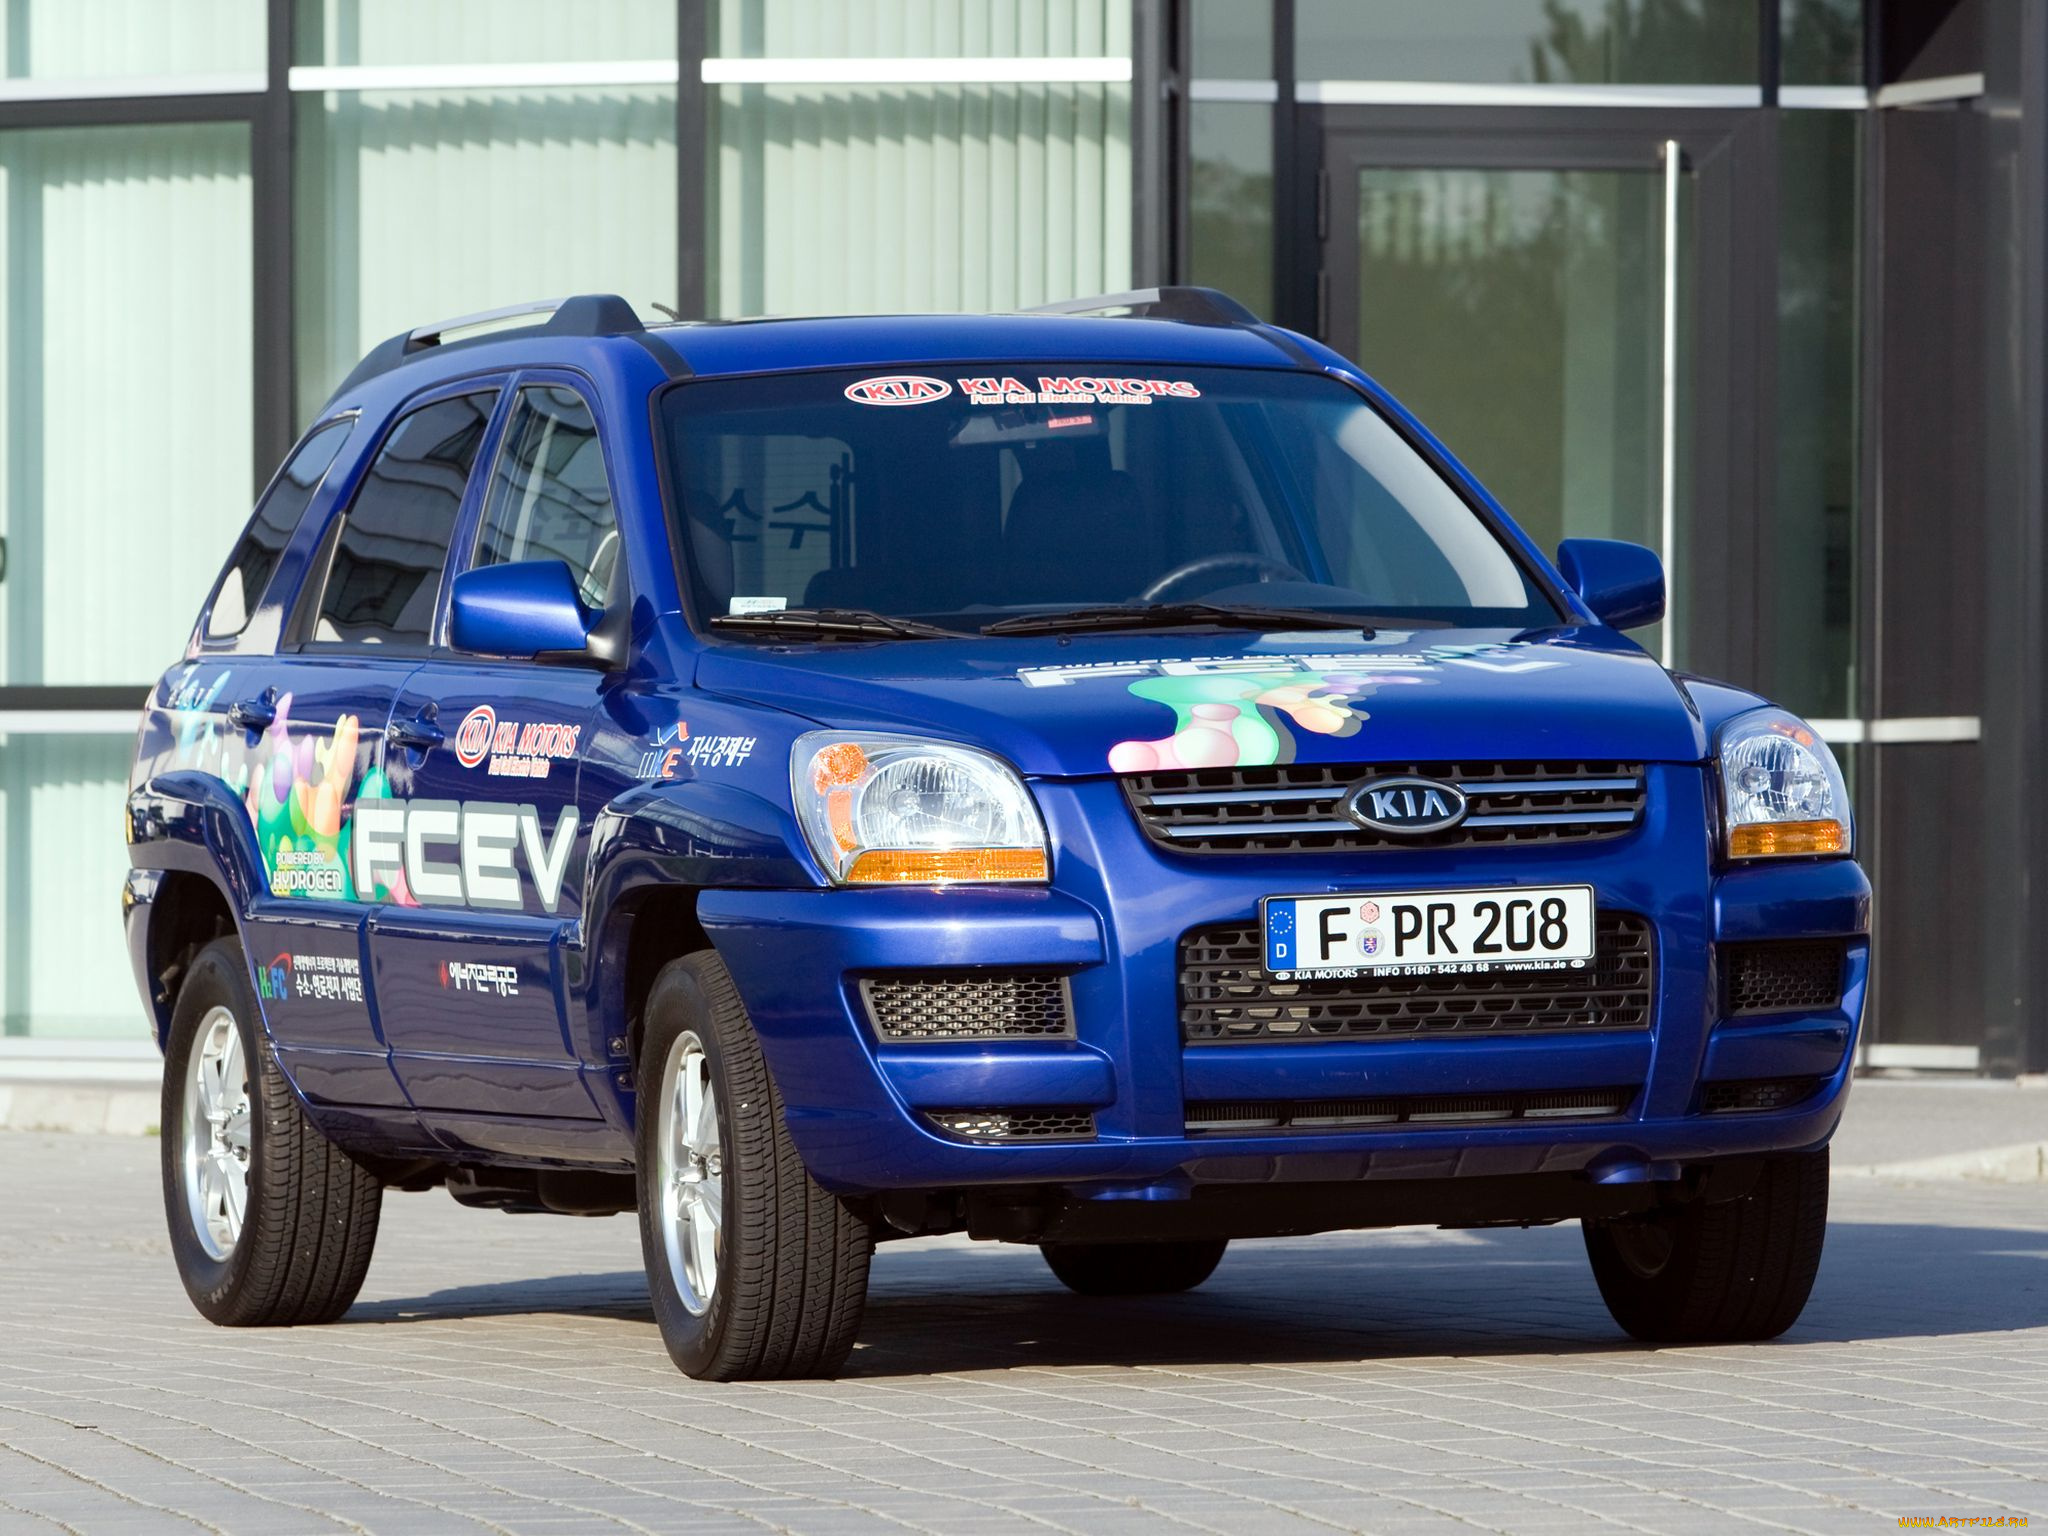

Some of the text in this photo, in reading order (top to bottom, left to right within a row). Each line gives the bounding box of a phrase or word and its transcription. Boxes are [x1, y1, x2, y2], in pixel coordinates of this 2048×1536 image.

[861, 379, 940, 401] KIA
[957, 377, 1201, 398] KIA MOTORS
[970, 393, 1153, 405] Fuel Cell Electric Vehicle
[491, 721, 581, 759] KIA MOTORS
[686, 735, 757, 767] 지식경제부
[1369, 790, 1450, 819] KIA
[275, 851, 326, 866] POWERED BY
[354, 803, 580, 909] FCEV
[272, 869, 343, 892] HYDROGEN
[1319, 897, 1569, 960] F PR 208
[1275, 942, 1288, 959] D
[448, 961, 519, 998] 에너지관리공단
[1294, 970, 1314, 981] KIA
[1314, 969, 1358, 981] MOTORS
[1373, 967, 1400, 977] INFO
[1504, 959, 1567, 972] www.kia.de
